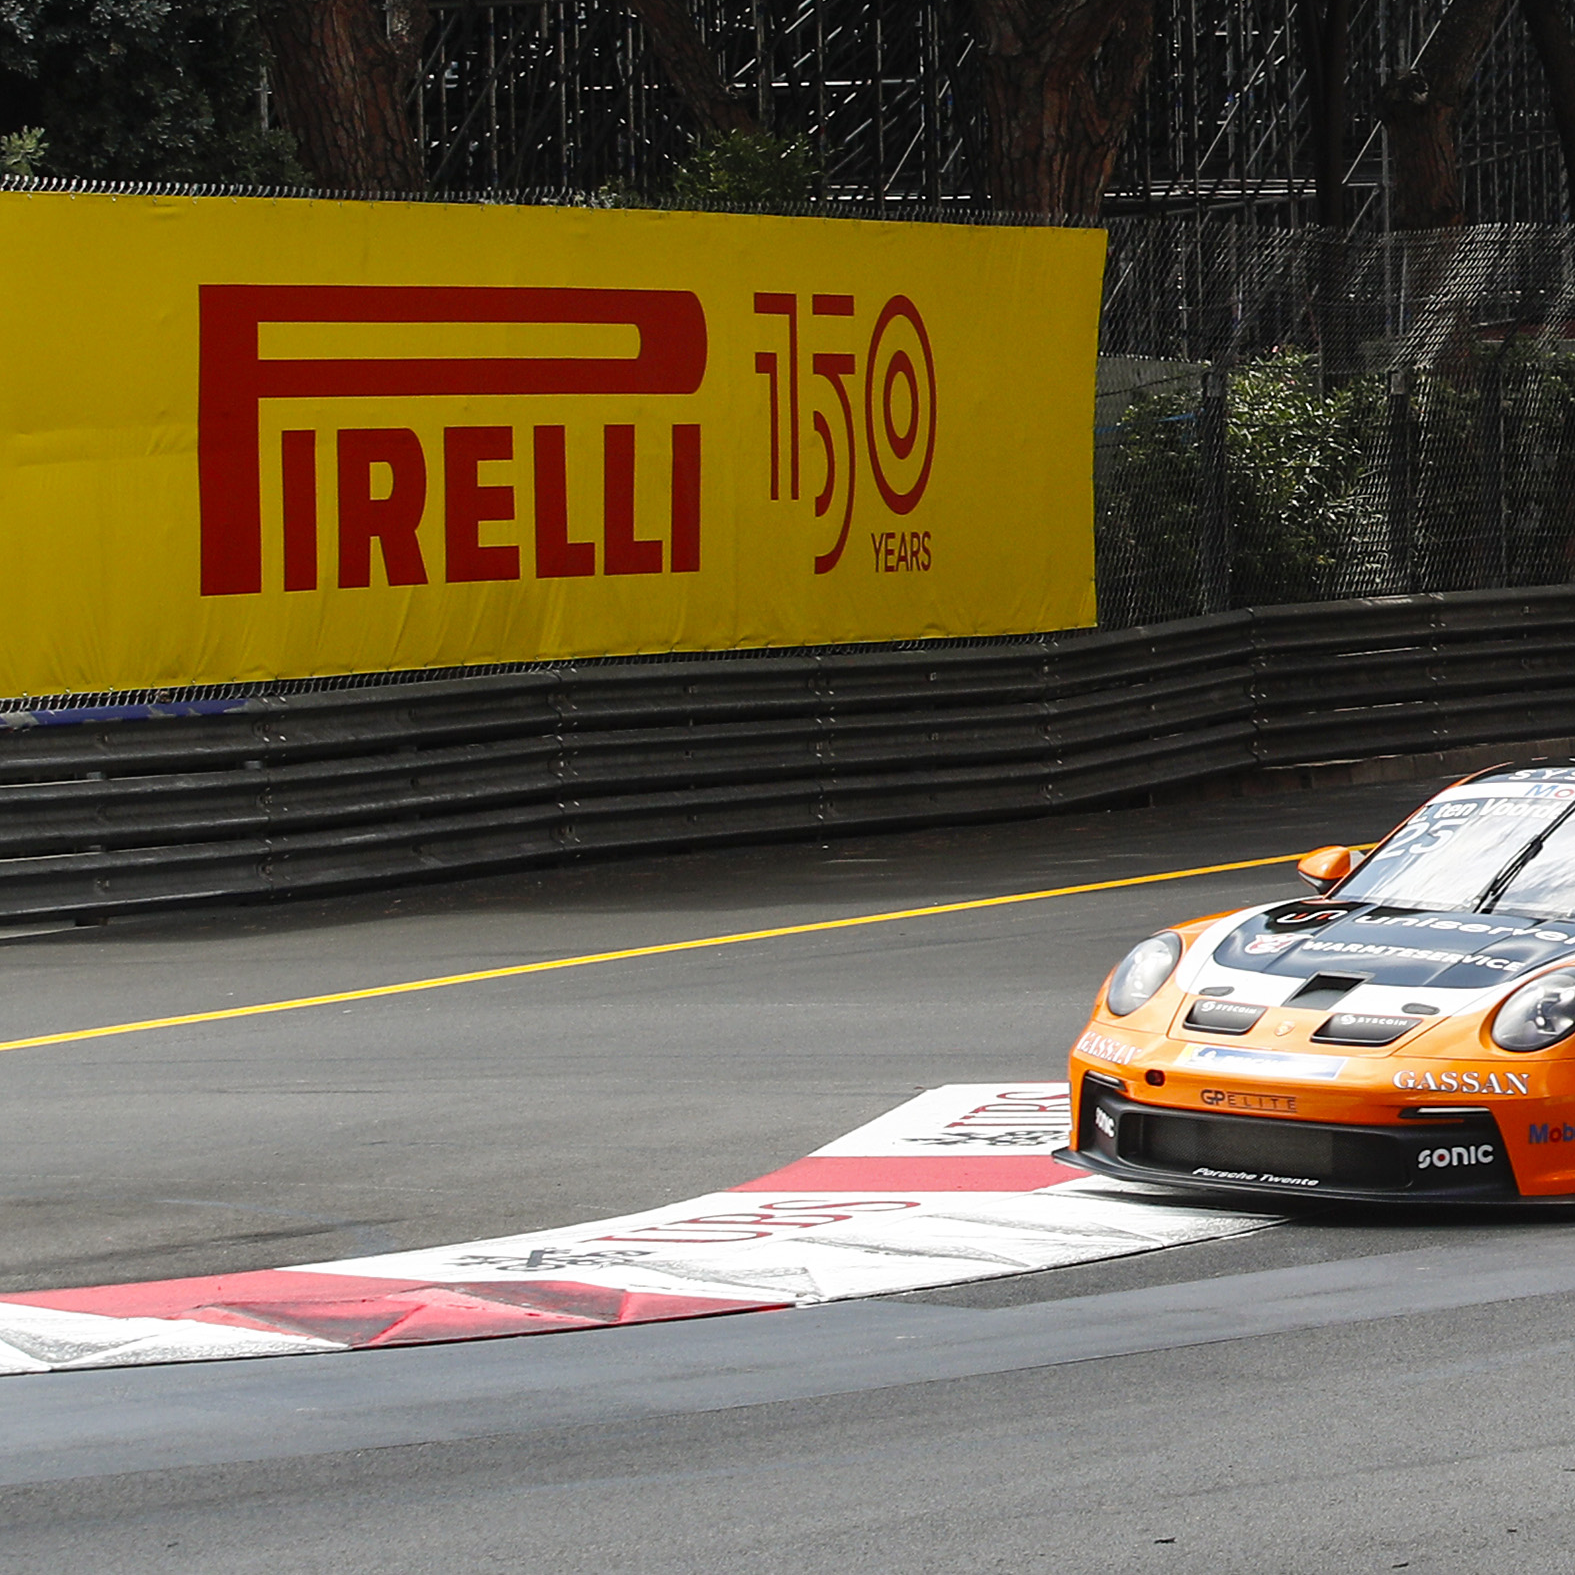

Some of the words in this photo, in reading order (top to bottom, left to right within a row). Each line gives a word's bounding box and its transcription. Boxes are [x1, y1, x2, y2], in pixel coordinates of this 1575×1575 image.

[199, 283, 708, 597] PIRELLI
[870, 530, 932, 573] YEARS
[1433, 800, 1479, 820] ten
[1479, 798, 1563, 821] Voorde
[1302, 940, 1526, 973] WARMTESERVICE
[1356, 1015, 1409, 1027] SYSCOIN
[1076, 1030, 1141, 1065] GASSAN
[1392, 1070, 1530, 1096] GASSAN
[1193, 1167, 1257, 1182] Porsche
[1259, 1172, 1320, 1187] Twente
[579, 1199, 922, 1244] UBS
